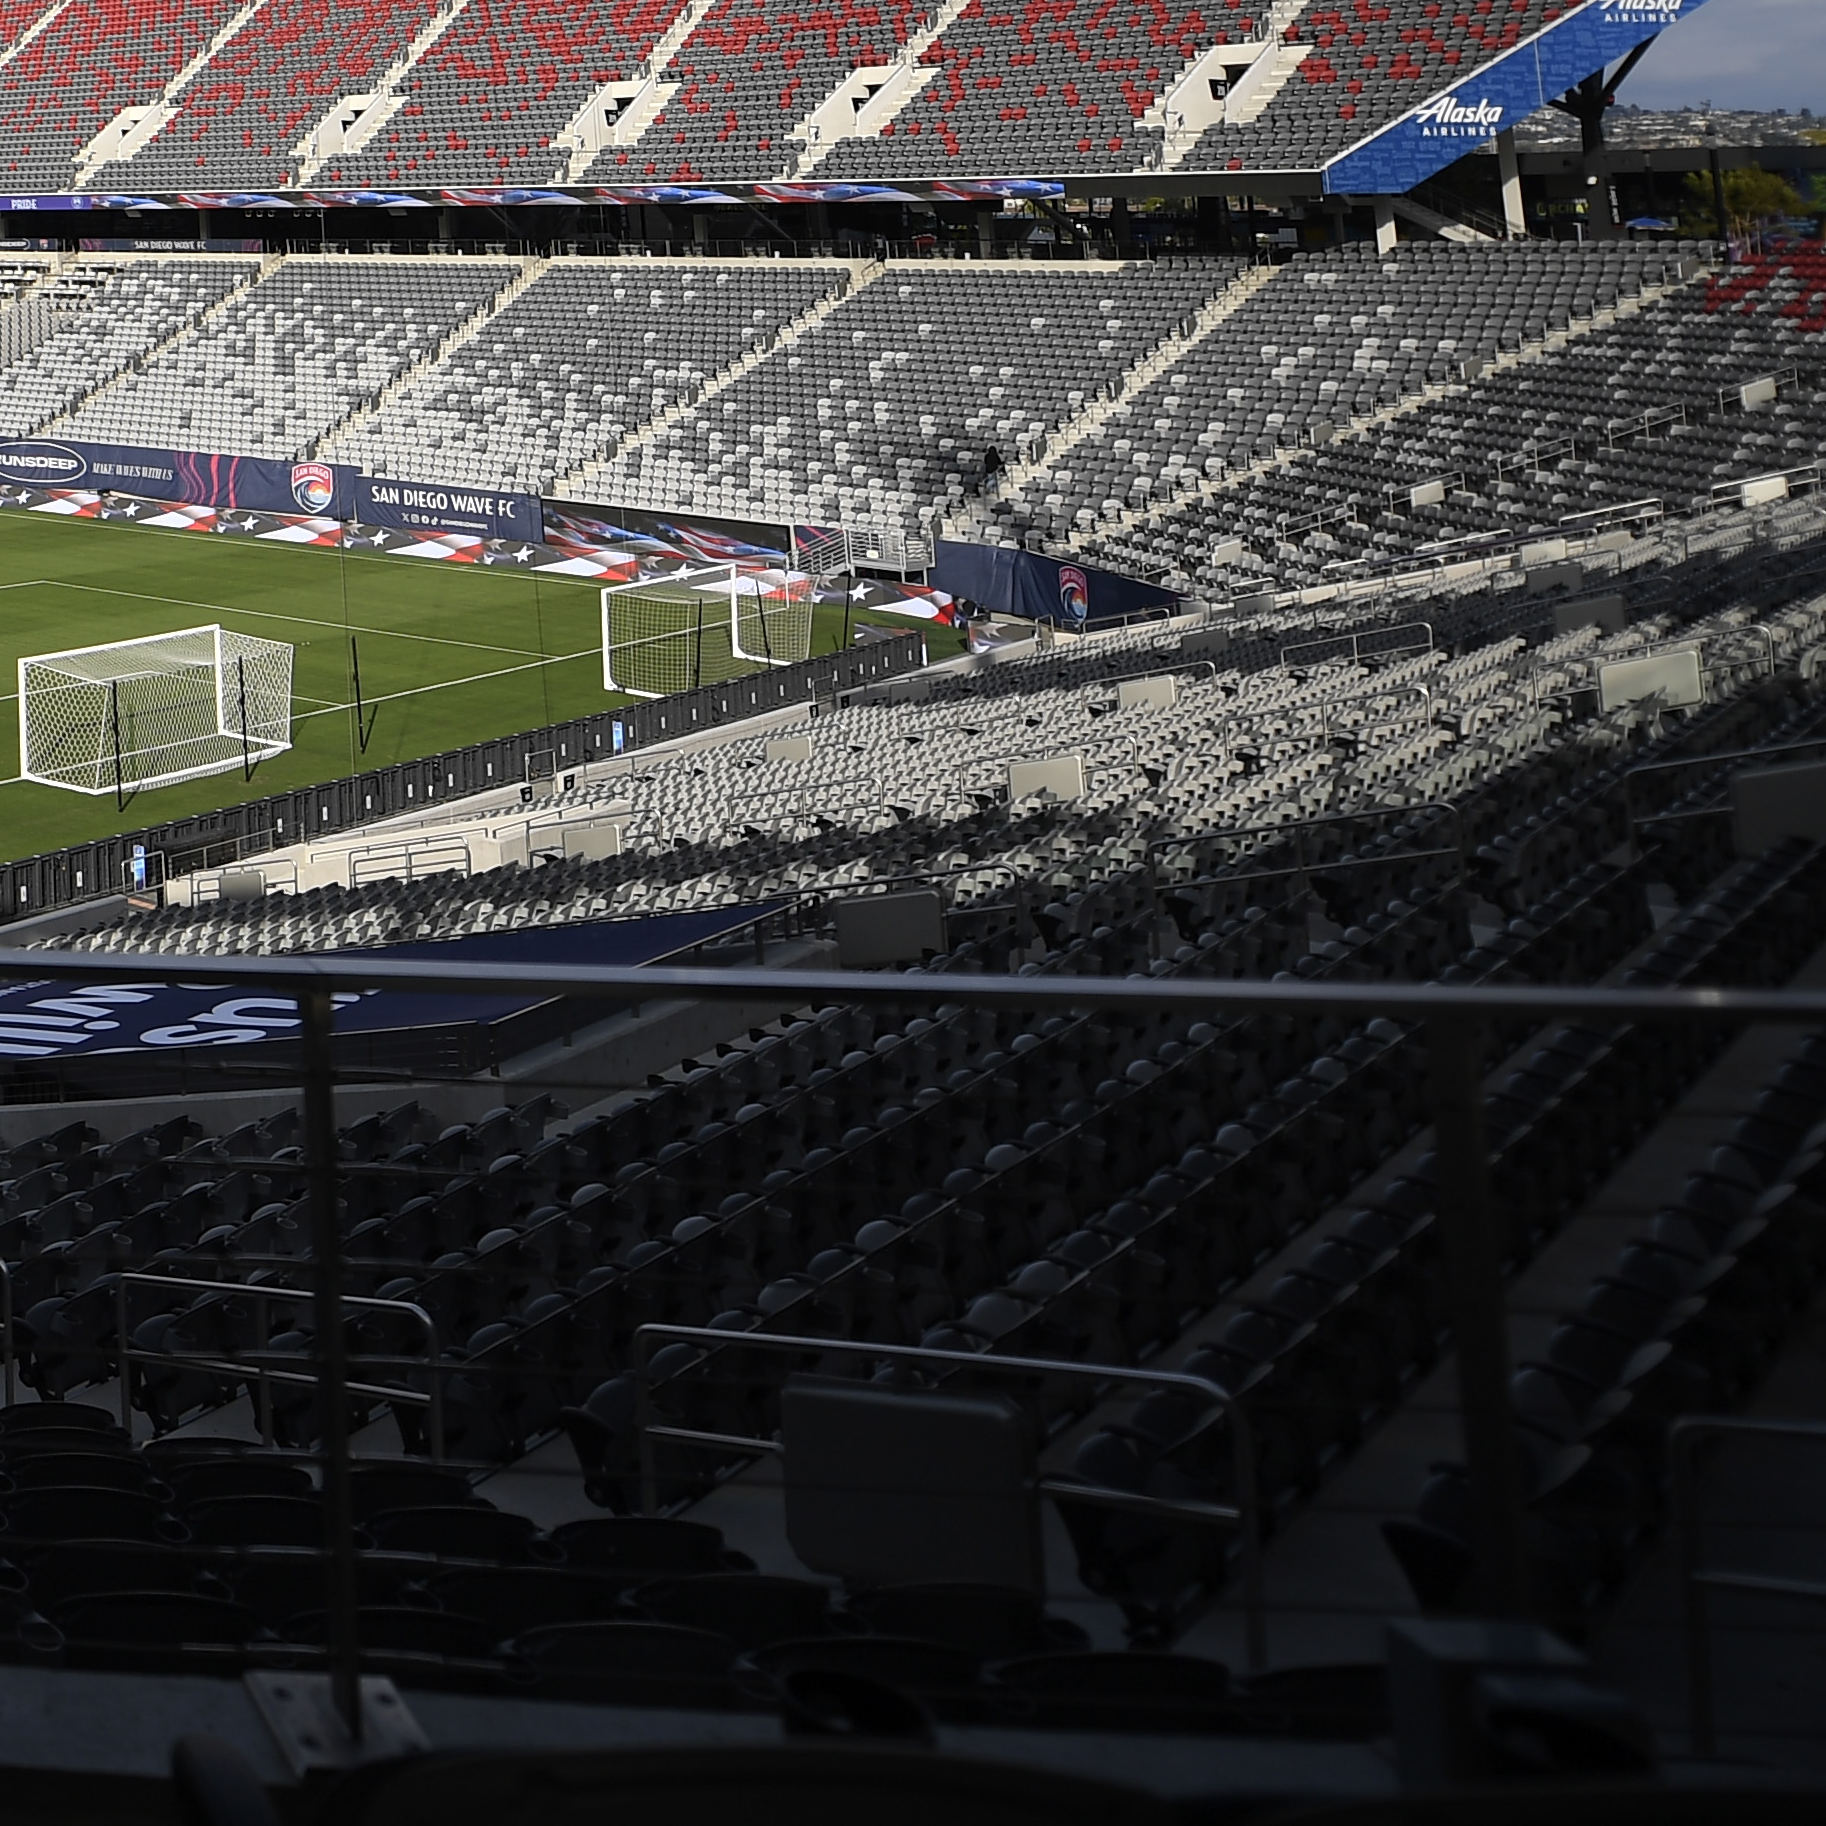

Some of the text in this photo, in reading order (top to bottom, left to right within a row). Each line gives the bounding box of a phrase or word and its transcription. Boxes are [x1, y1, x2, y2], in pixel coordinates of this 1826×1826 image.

[1604, 13, 1677, 23] AIRLINES
[1415, 97, 1503, 125] Alaska
[1422, 126, 1497, 137] AIRLINES
[11, 199, 38, 210] PRIDE
[294, 467, 329, 480] SAN DIEGO
[371, 485, 516, 519] SAN DIEGO WAVE FC
